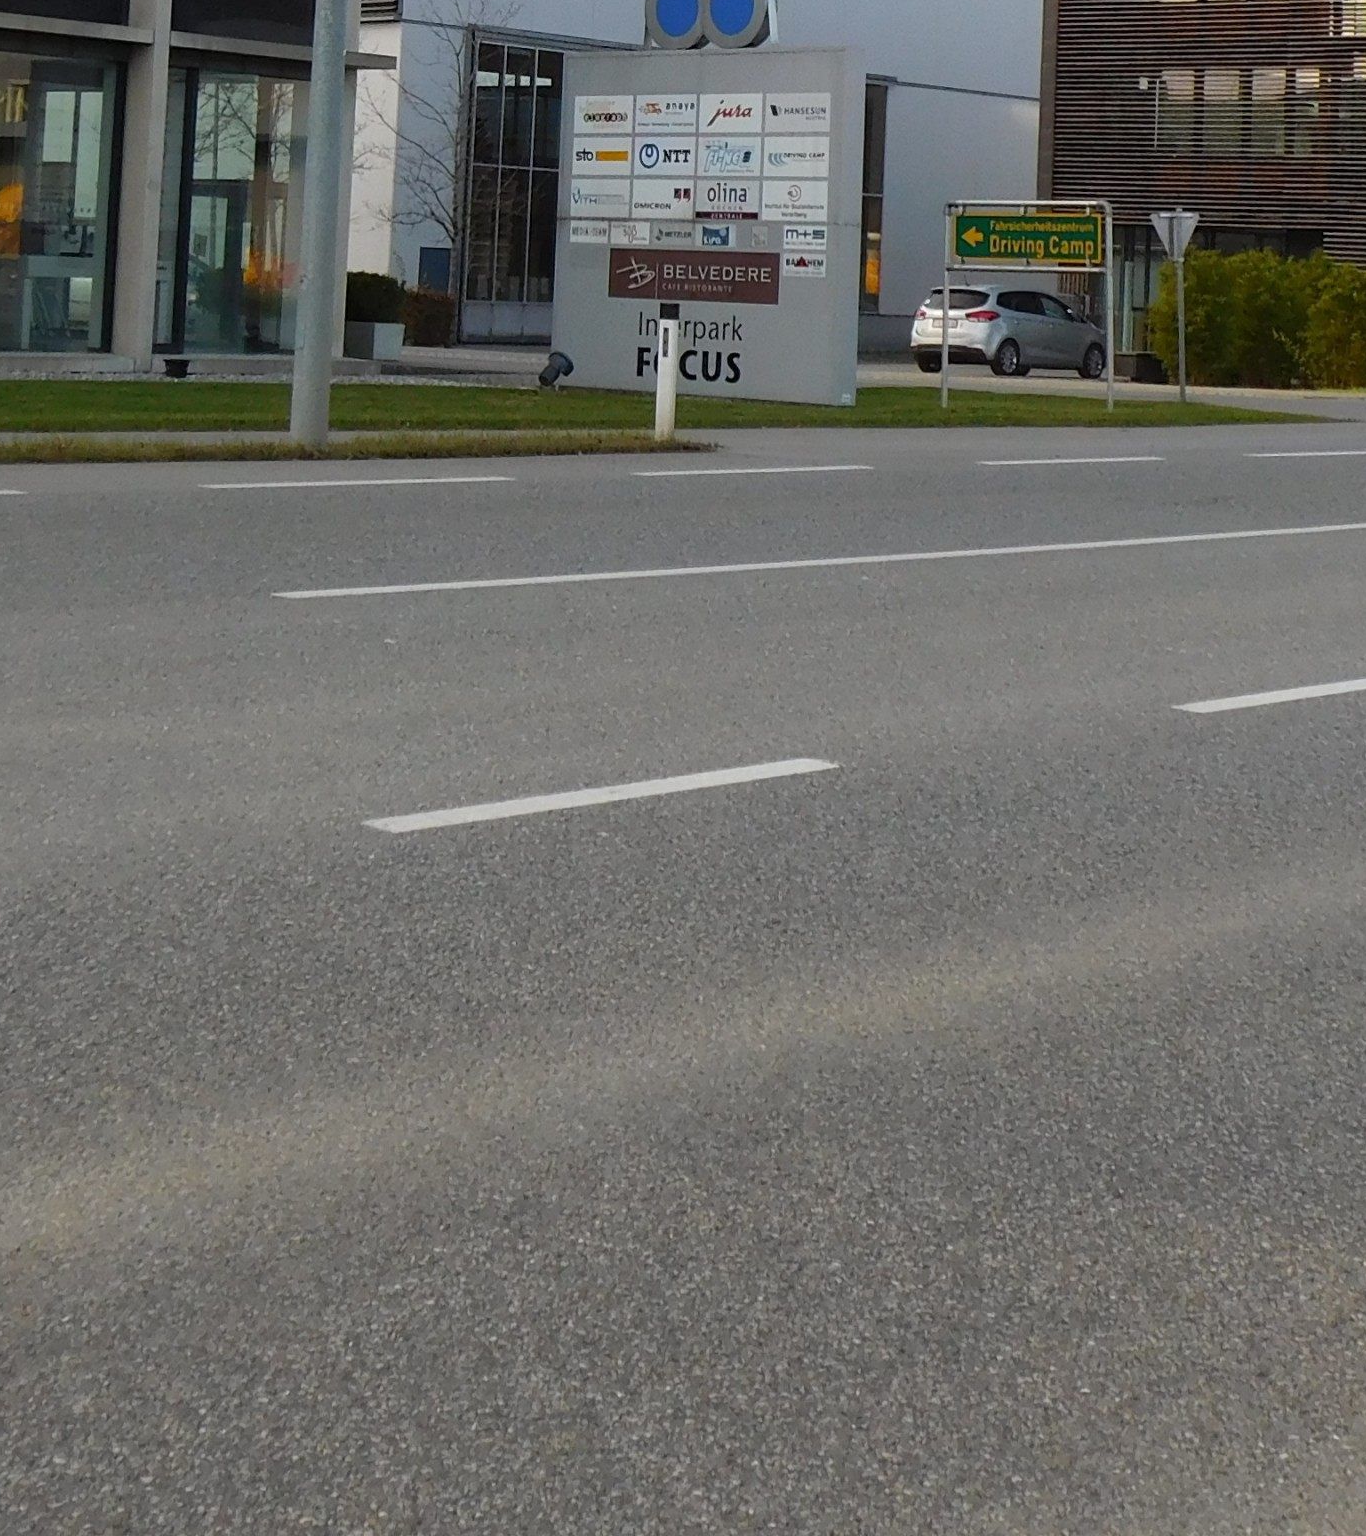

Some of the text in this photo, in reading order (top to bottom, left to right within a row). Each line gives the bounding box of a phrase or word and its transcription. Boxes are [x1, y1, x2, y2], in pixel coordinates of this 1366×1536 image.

[707, 99, 753, 127] jura
[784, 106, 827, 116] HANSESUN
[575, 148, 594, 162] sto
[662, 149, 691, 163] NTT
[707, 183, 747, 203] olina
[989, 220, 1094, 233] Fahrsicherheitszentrum
[989, 234, 1094, 258] Driving Camp
[663, 264, 772, 283] BELVEDERE
[638, 311, 743, 347] Inrpark
[636, 347, 741, 384] FCUS
